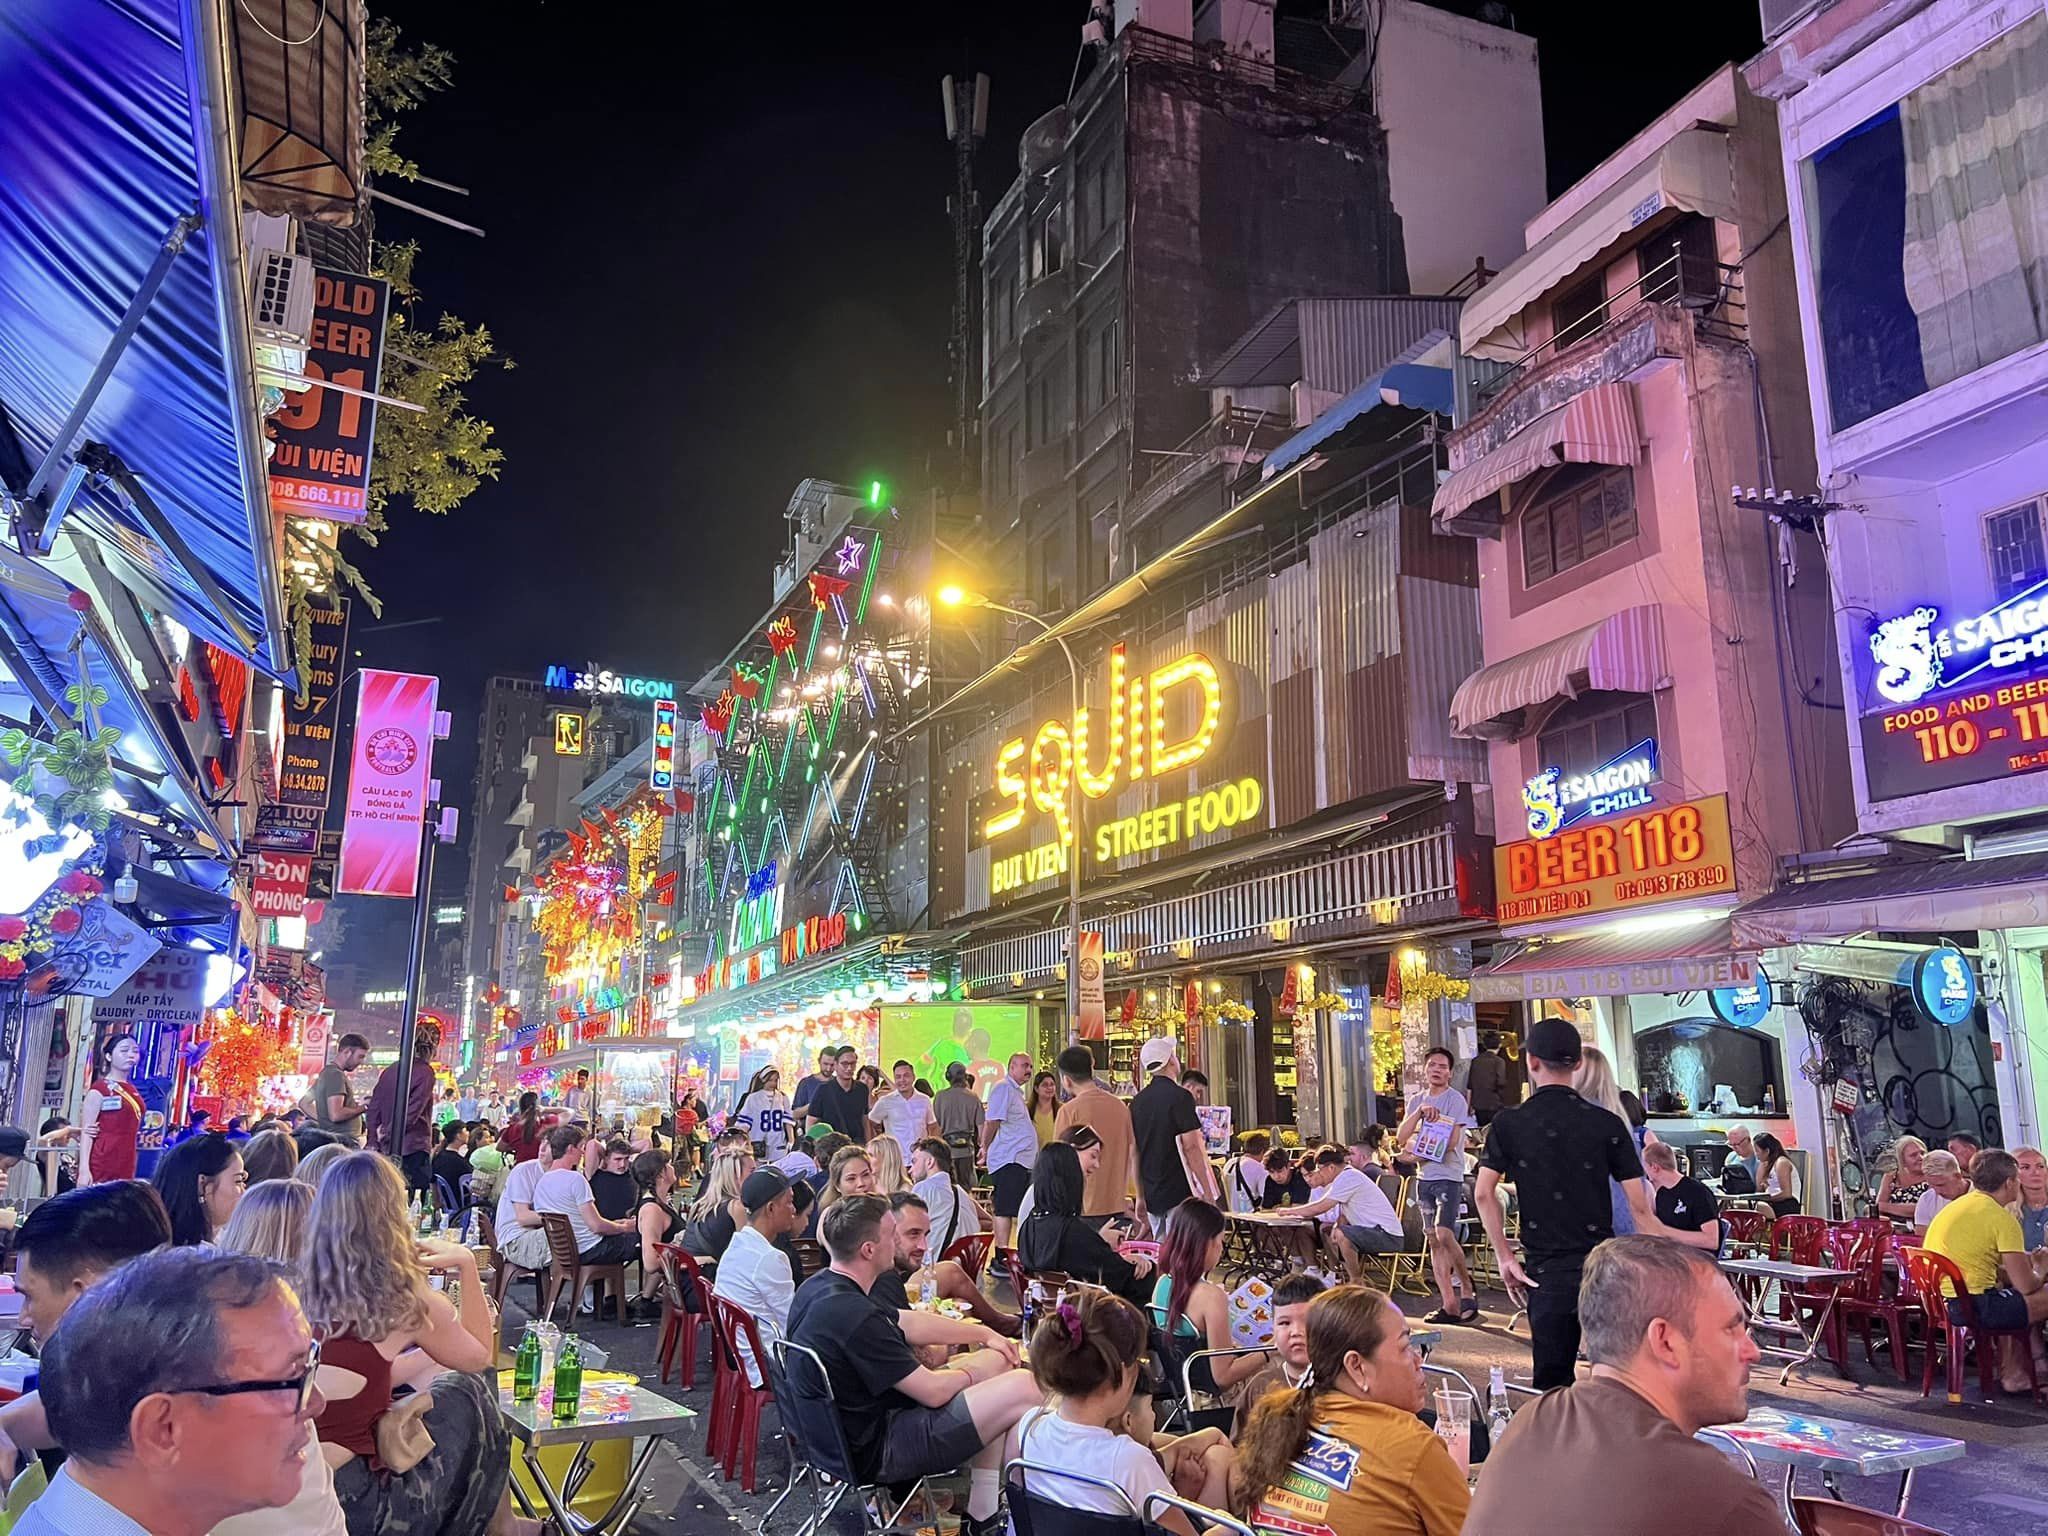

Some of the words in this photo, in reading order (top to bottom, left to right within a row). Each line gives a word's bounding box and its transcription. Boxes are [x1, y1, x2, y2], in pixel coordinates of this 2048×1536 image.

[316, 277, 376, 316] OLD
[311, 319, 372, 358] EER
[308, 448, 363, 478] VIỆN
[598, 670, 674, 699] SAIGON
[1884, 707, 1940, 733] FOOD
[1946, 693, 1991, 718] AND
[305, 723, 331, 742] VIỆN
[654, 709, 674, 786] TATTOO
[986, 641, 1221, 847] SQUID
[1915, 720, 1977, 763] 110
[2012, 701, 2048, 741] 11
[287, 755, 320, 770] Phone
[1570, 759, 1650, 802] SAIGON
[1590, 788, 1653, 817] CHILL
[1097, 802, 1183, 862] STREET
[1186, 777, 1262, 839] FOOD
[1508, 825, 1620, 894] BEER
[1622, 805, 1703, 872] 118
[992, 854, 1023, 895] BUI
[1025, 842, 1068, 883] VIEN
[1637, 875, 1668, 897] 0913
[1670, 871, 1696, 891] 738
[1698, 865, 1725, 886] 890
[253, 886, 303, 913] PHÒNG
[1499, 902, 1518, 920] 118
[1532, 973, 1569, 994] BIA
[1578, 971, 1622, 992] 118
[95, 1007, 135, 1019] LAUDRY
[147, 1008, 200, 1022] DRYCLEAN
[760, 1109, 783, 1133] 88
